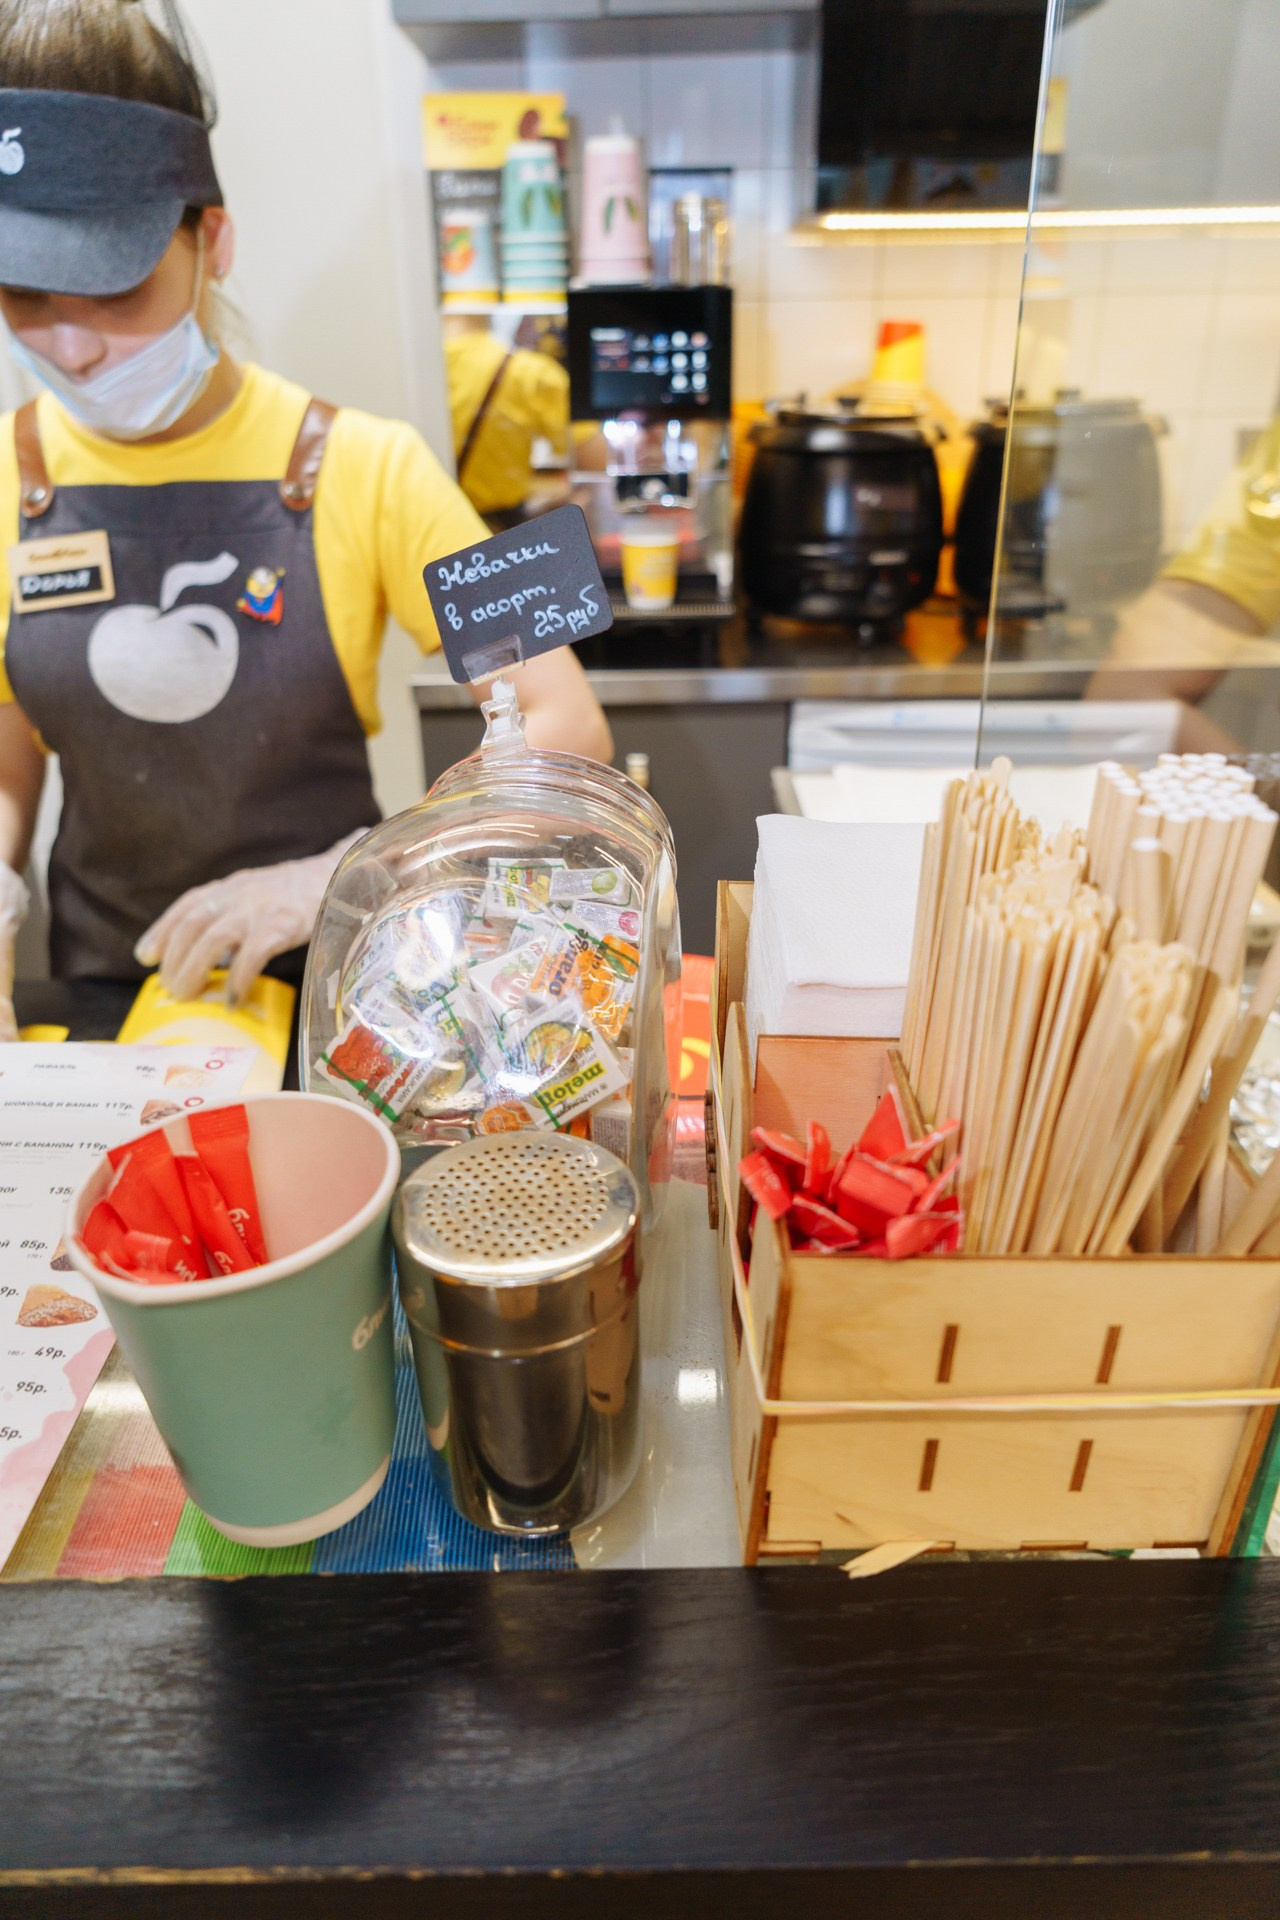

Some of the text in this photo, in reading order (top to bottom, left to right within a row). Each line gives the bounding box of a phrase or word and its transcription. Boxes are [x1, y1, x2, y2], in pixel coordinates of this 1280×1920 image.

[444, 585, 556, 631] в асорт.
[540, 1062, 605, 1107] melon
[24, 1141, 74, 1149] БАНАНОМ
[20, 1240, 48, 1250] 85р.
[34, 1347, 66, 1360] 49р.
[16, 1381, 47, 1396] 95р.
